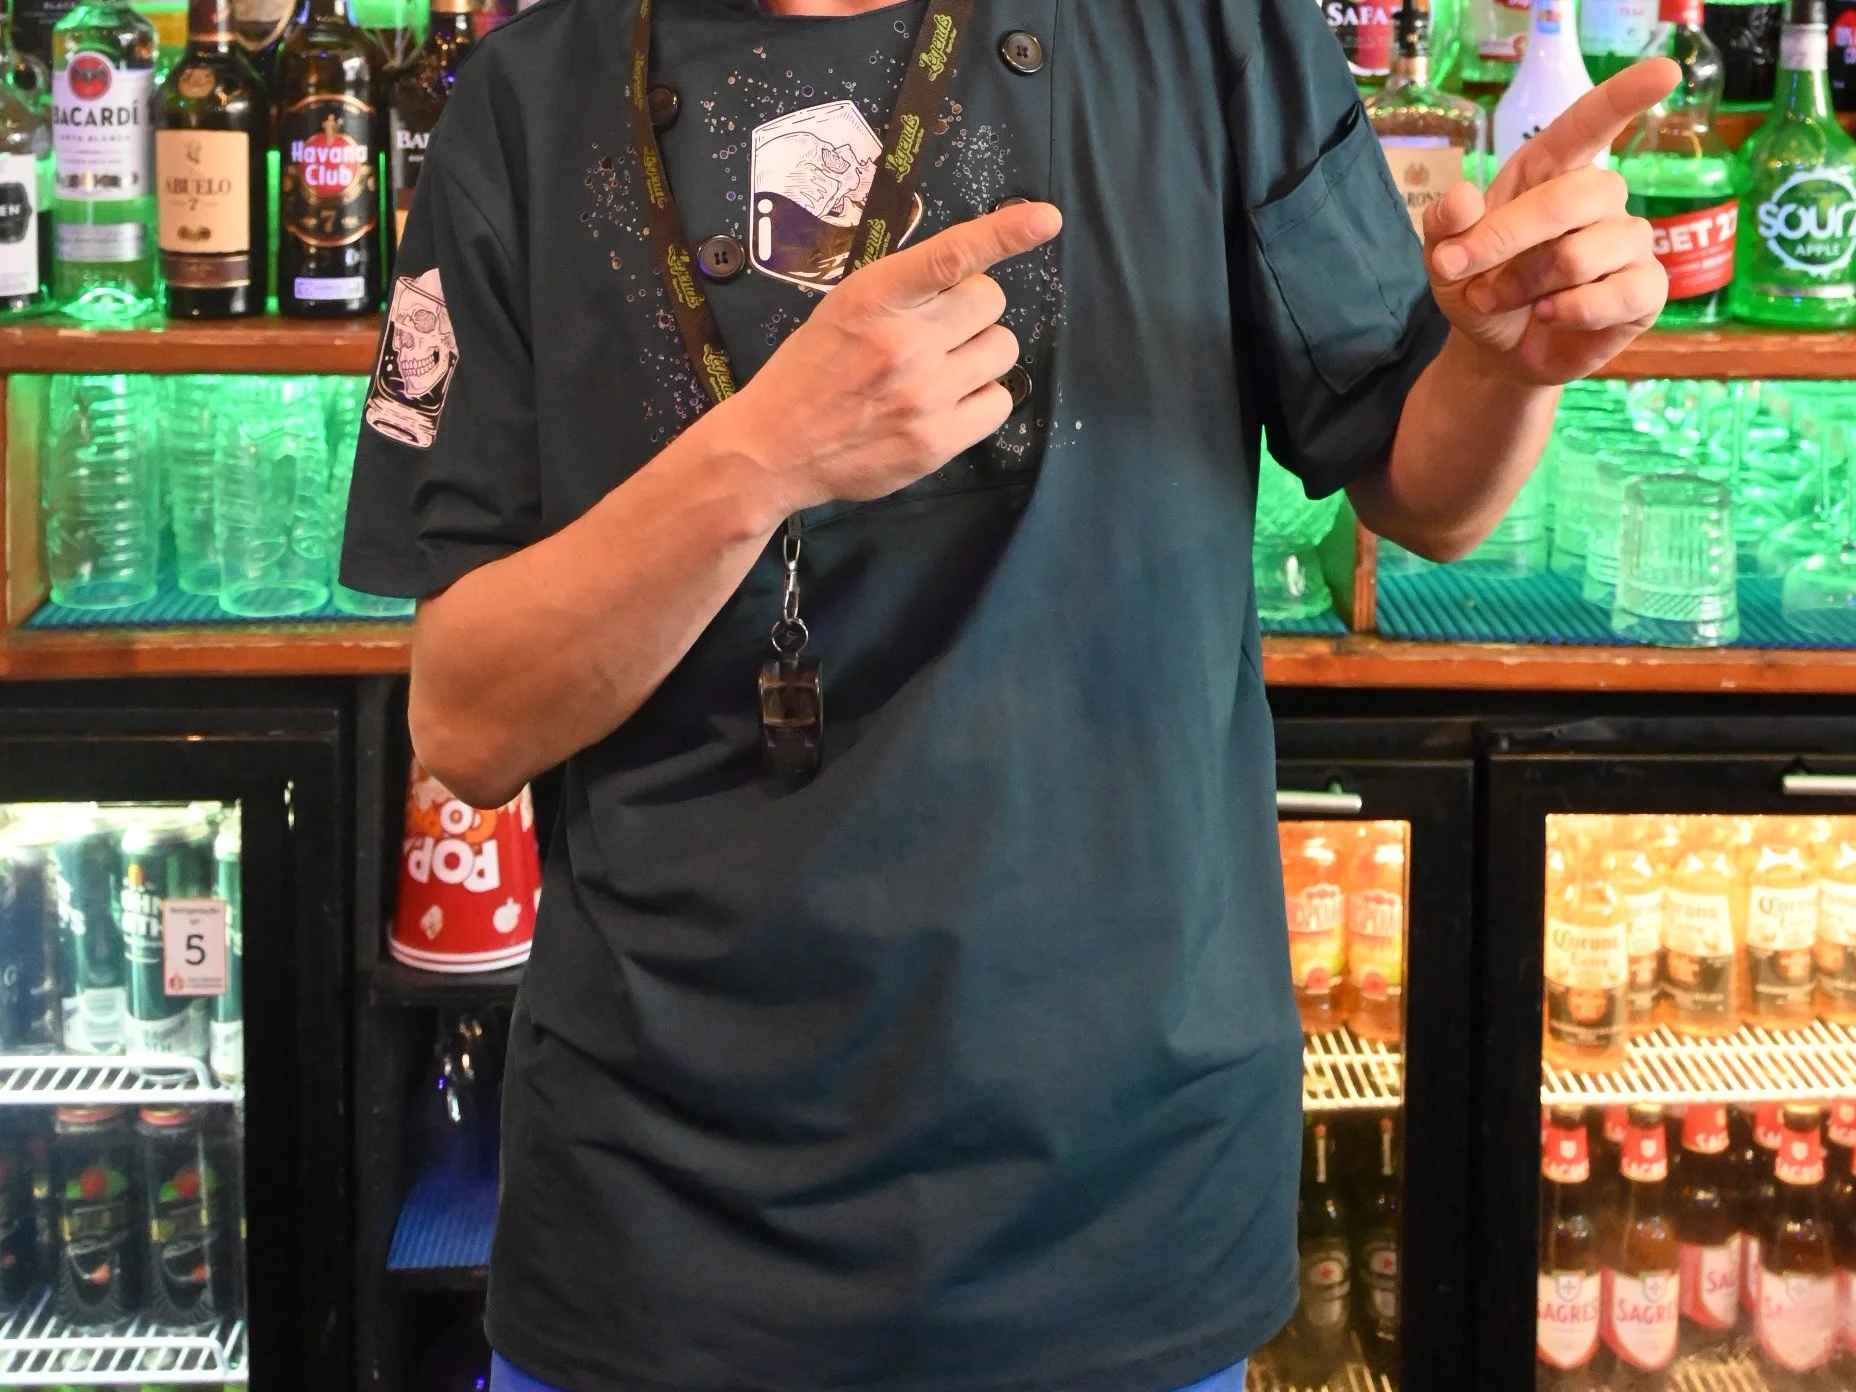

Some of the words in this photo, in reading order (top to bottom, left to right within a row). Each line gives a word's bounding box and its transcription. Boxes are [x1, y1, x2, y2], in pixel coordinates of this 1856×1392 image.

[919, 14, 952, 81] Legends
[291, 139, 368, 163] Havana
[885, 114, 920, 183] Legends
[305, 164, 353, 186] Club
[321, 210, 336, 233] 7
[1653, 219, 1713, 255] GET
[1794, 243, 1841, 257] APPLE
[185, 933, 206, 966] 5
